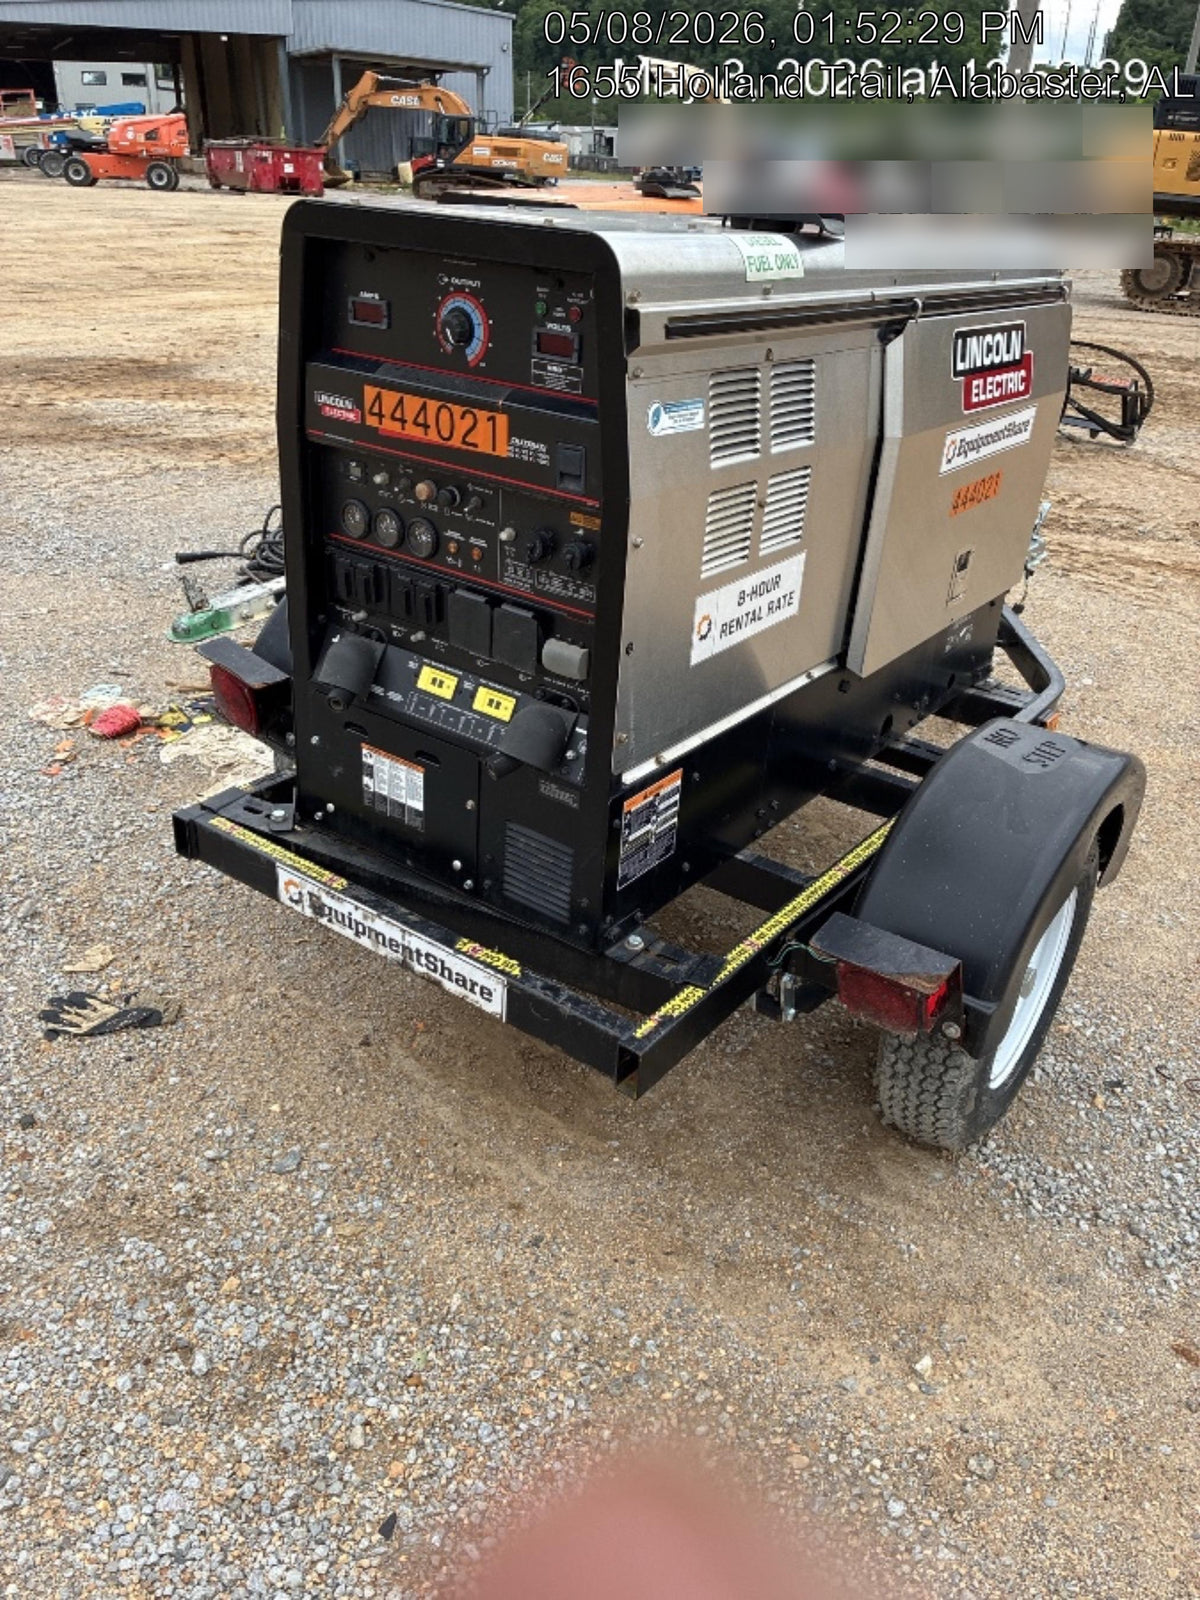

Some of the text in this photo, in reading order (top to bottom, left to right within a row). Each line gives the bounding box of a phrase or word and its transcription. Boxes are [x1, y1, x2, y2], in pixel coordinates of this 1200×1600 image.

[391, 96, 420, 106] CASE
[746, 253, 799, 272] FUEL ONLY
[956, 330, 1021, 371] LINCOLN
[971, 369, 1026, 402] ELECTRIC
[368, 390, 498, 452] 444021
[956, 419, 1031, 458] EquipmentShare
[951, 471, 1001, 516] 444021
[737, 574, 782, 607] 8-HOUR
[719, 590, 796, 640] RENTAL RATE
